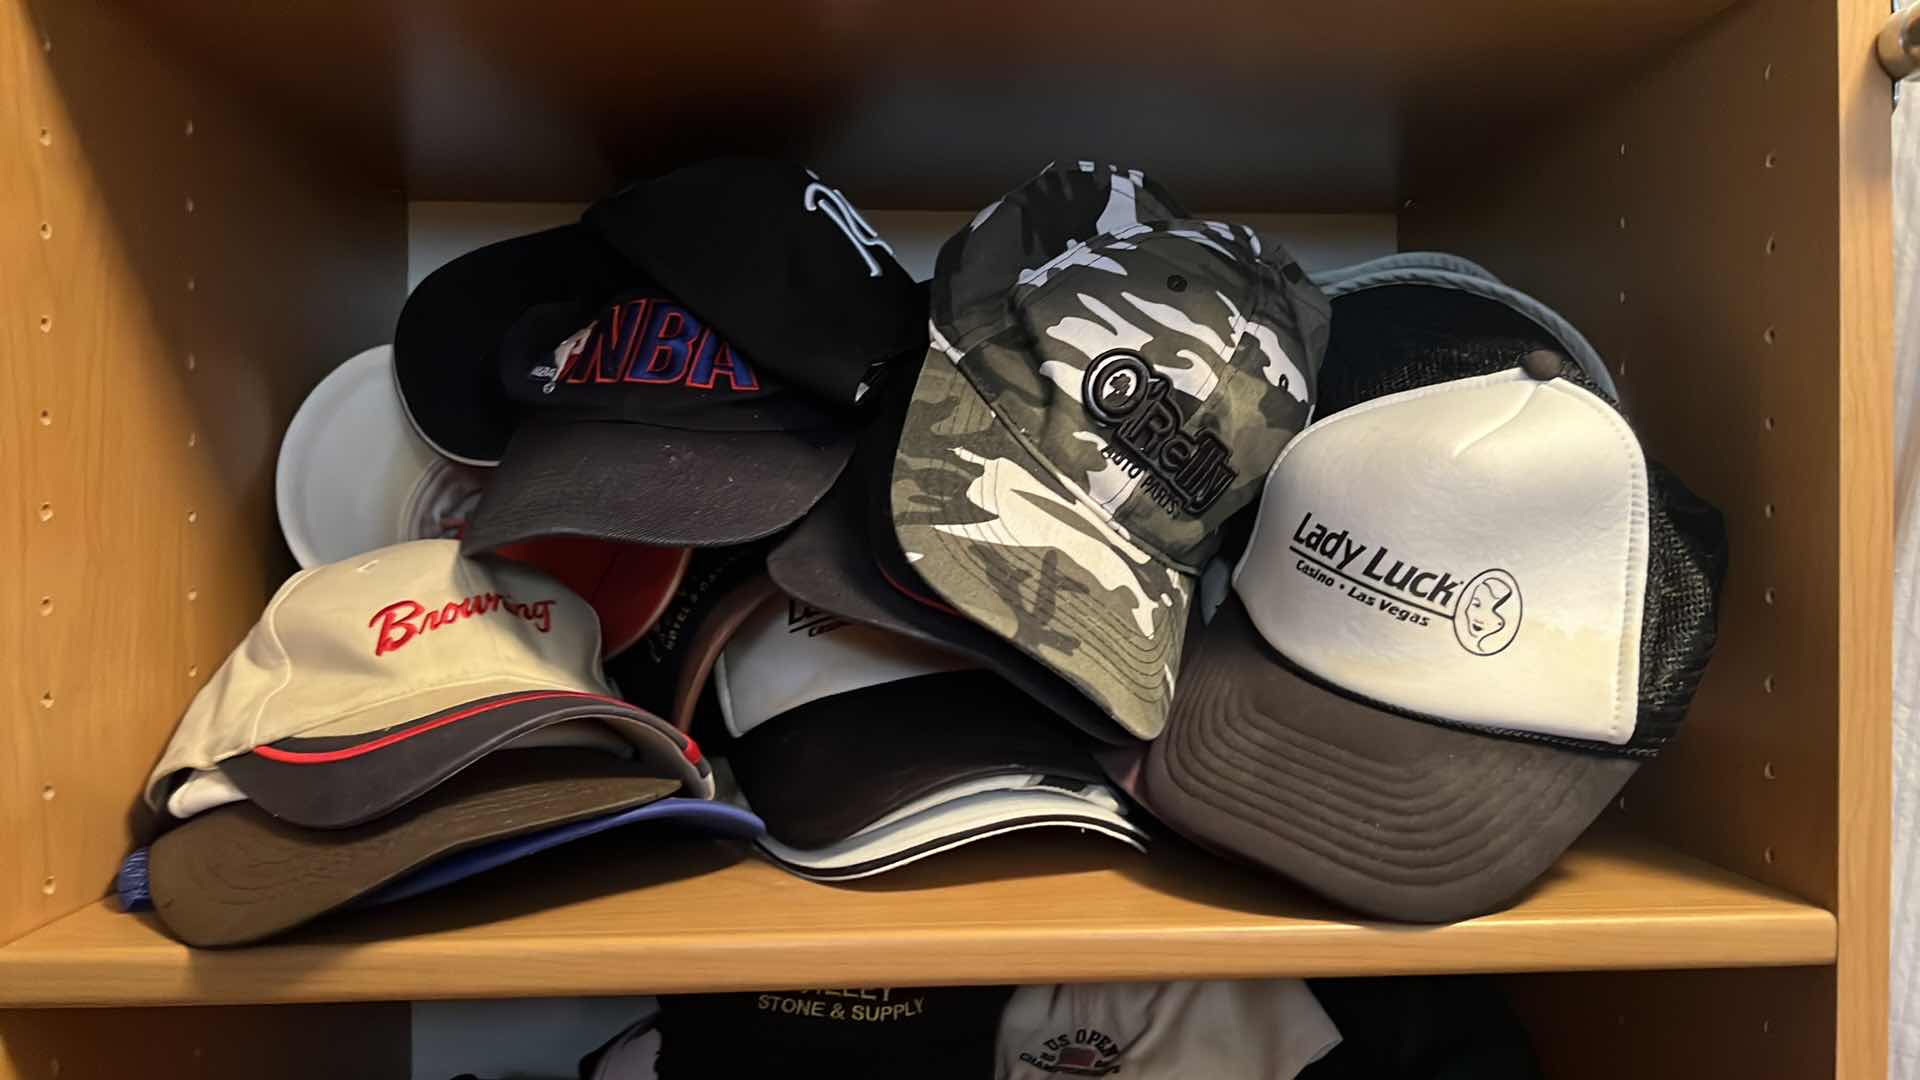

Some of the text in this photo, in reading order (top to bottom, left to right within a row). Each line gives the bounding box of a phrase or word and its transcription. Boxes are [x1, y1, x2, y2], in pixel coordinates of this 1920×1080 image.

[563, 296, 761, 392] NBA
[1101, 446, 1181, 519] AUTO PARTS
[1293, 512, 1458, 607] Lady Luck
[369, 591, 557, 657] Browning
[1296, 560, 1430, 627] Casino Las Vegas
[758, 994, 826, 1018] STONE
[830, 1002, 845, 1020] &
[851, 996, 925, 1023] SUPPLY
[1076, 1029, 1119, 1057] OPEN
